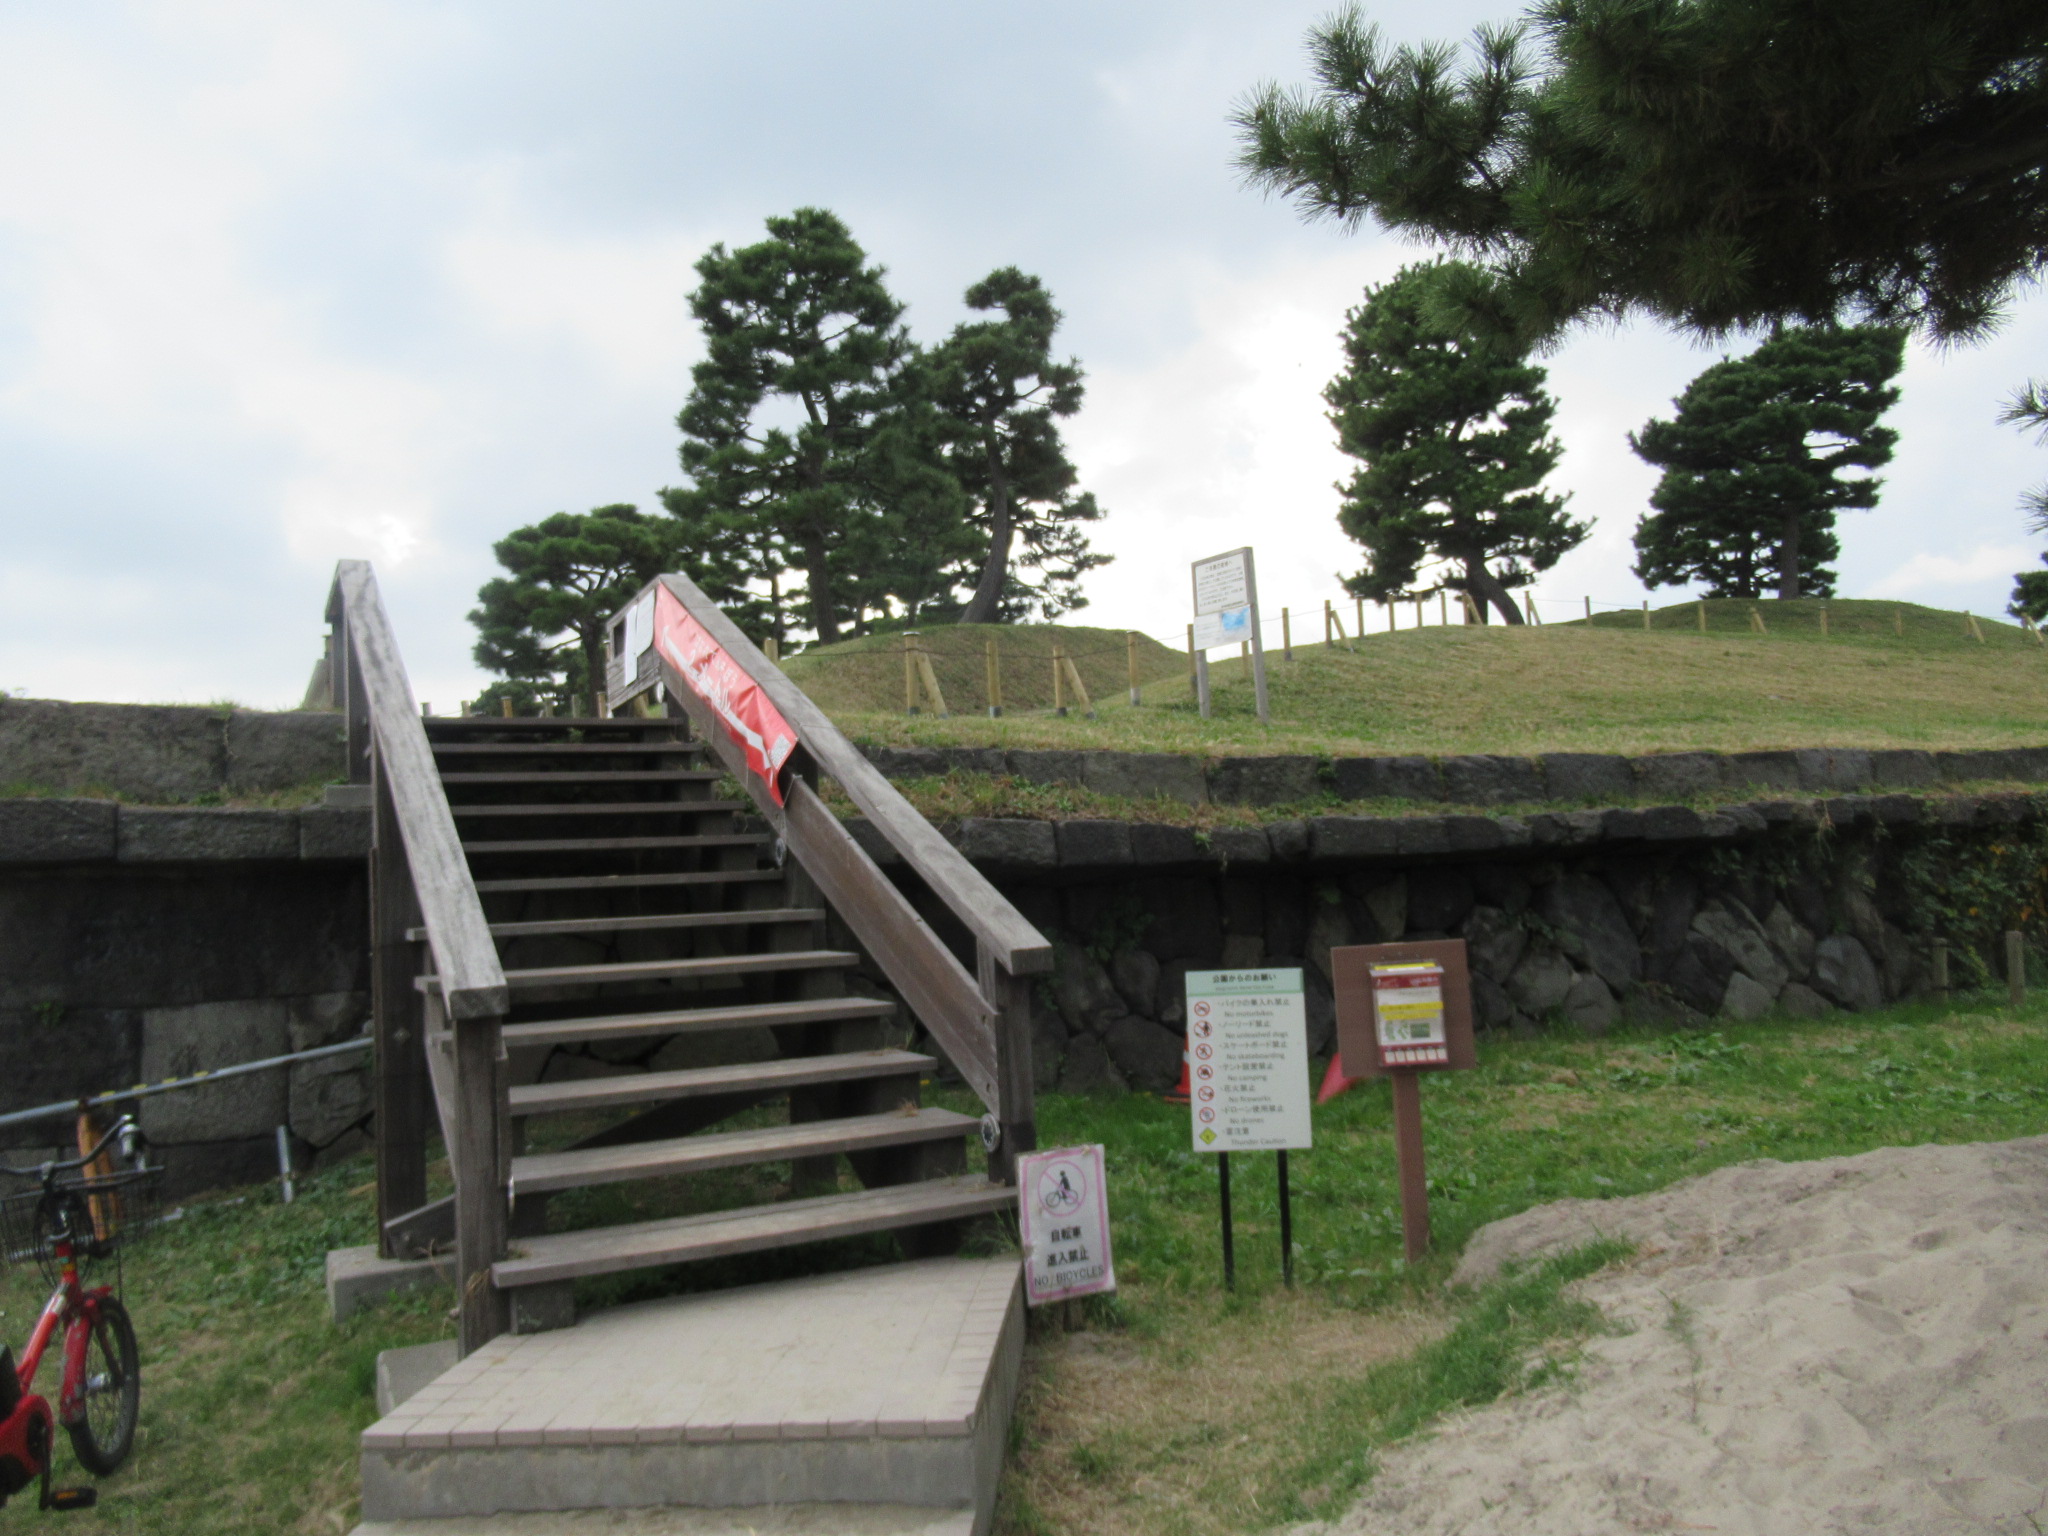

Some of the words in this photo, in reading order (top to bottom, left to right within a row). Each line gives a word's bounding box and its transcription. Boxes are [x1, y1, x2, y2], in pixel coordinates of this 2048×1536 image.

[1213, 974, 1276, 983] 公園からのお願い
[1051, 1226, 1081, 1243] 自転車
[1048, 1247, 1089, 1267] 進入禁止
[1034, 1275, 1048, 1286] NO
[1056, 1265, 1105, 1284] BICYCLES
